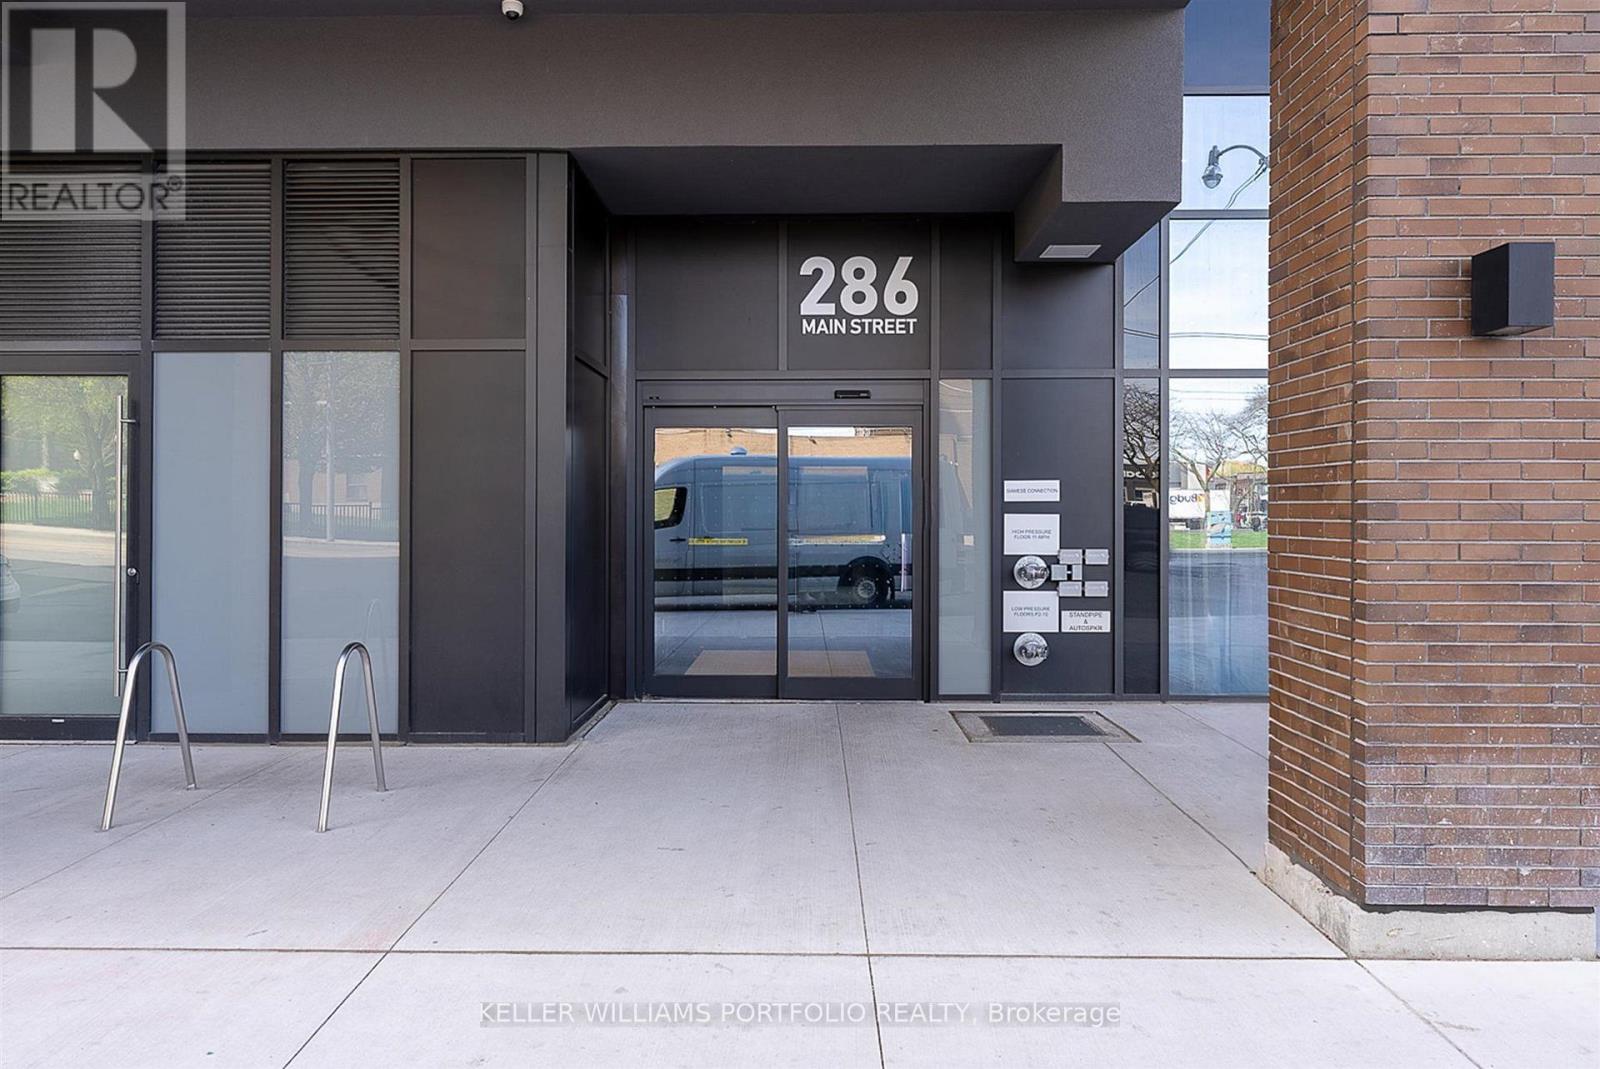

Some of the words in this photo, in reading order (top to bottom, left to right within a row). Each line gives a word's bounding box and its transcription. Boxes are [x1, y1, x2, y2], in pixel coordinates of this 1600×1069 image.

[799, 255, 919, 316] 286
[801, 318, 847, 335] MAIN
[849, 318, 918, 335] STREET
